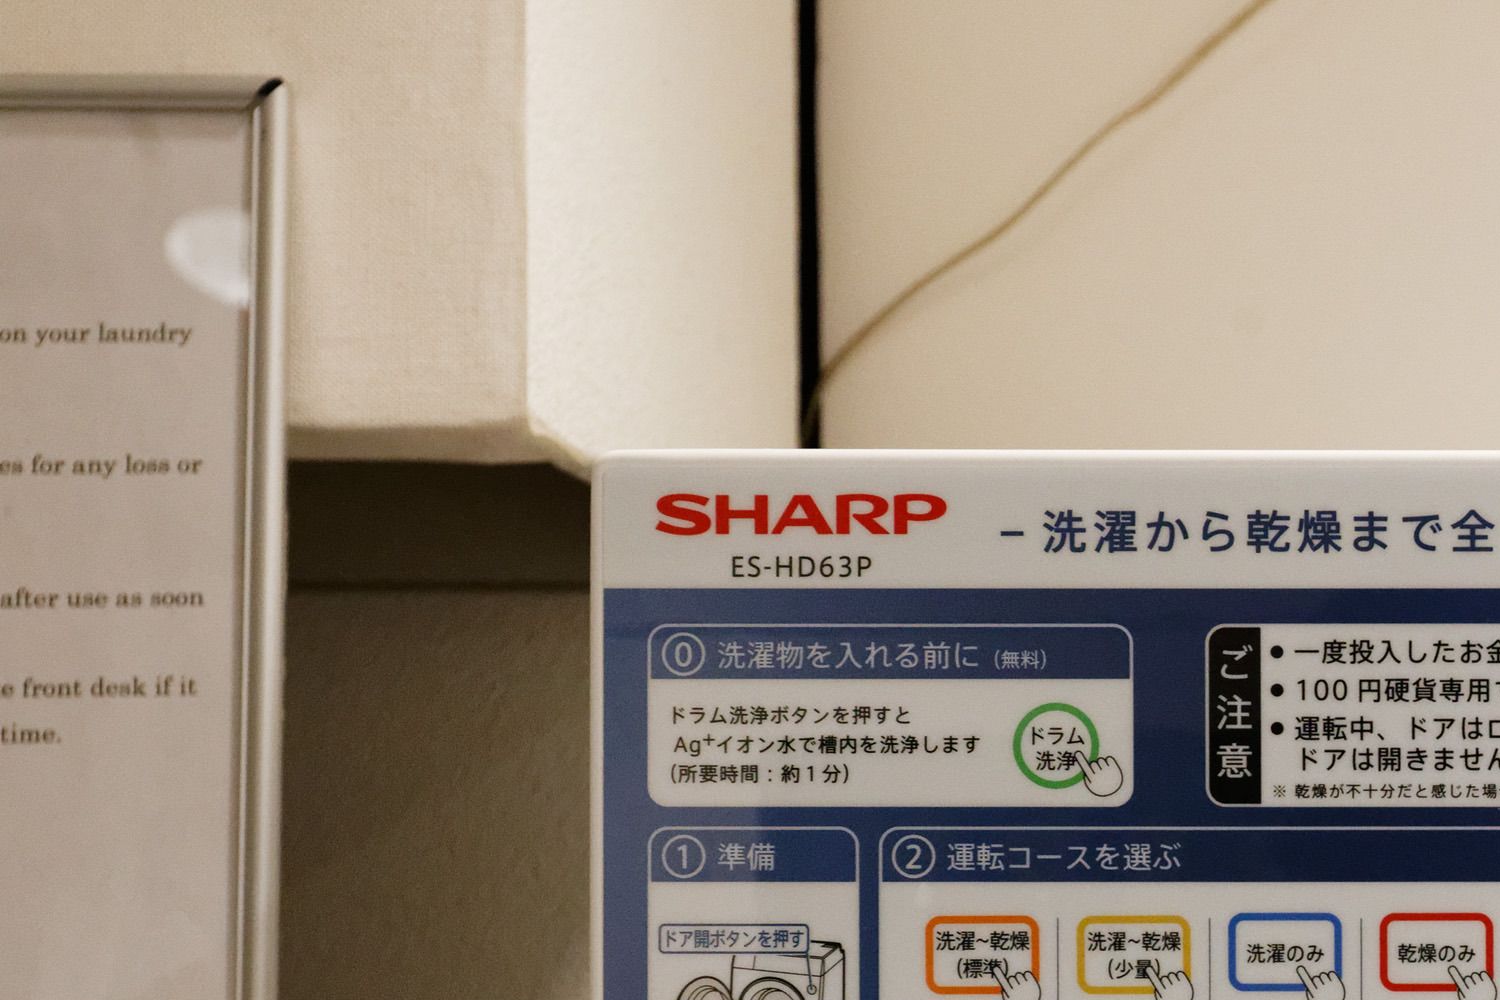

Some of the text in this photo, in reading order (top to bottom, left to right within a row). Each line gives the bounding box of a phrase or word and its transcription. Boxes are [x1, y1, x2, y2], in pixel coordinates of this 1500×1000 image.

[36, 329, 90, 347] your
[98, 322, 191, 346] laundry
[32, 455, 64, 474] for
[72, 461, 116, 478] any
[126, 454, 170, 474] loss
[177, 456, 202, 474] or
[656, 494, 947, 535] SHARP
[732, 556, 871, 577] ES-HD63P
[0, 588, 203, 608] after use as soon
[718, 640, 978, 669] 洗濯物を入れる前に
[23, 678, 81, 698] front
[91, 677, 145, 697] desk
[156, 676, 172, 696] if
[181, 677, 196, 696] it
[673, 706, 910, 724] ドラム洗浄ボタンを押すと
[1217, 645, 1253, 778] ご注意
[1, 725, 60, 744] time.
[1026, 723, 1089, 745] ドラム
[718, 842, 775, 871] 準備
[947, 843, 1181, 870] 運転コースを選ぶ
[664, 929, 804, 949] ドア開ボタンを押す
[1246, 943, 1324, 964] 洗濯のみ
[1397, 943, 1476, 964] 乾燥のみ
